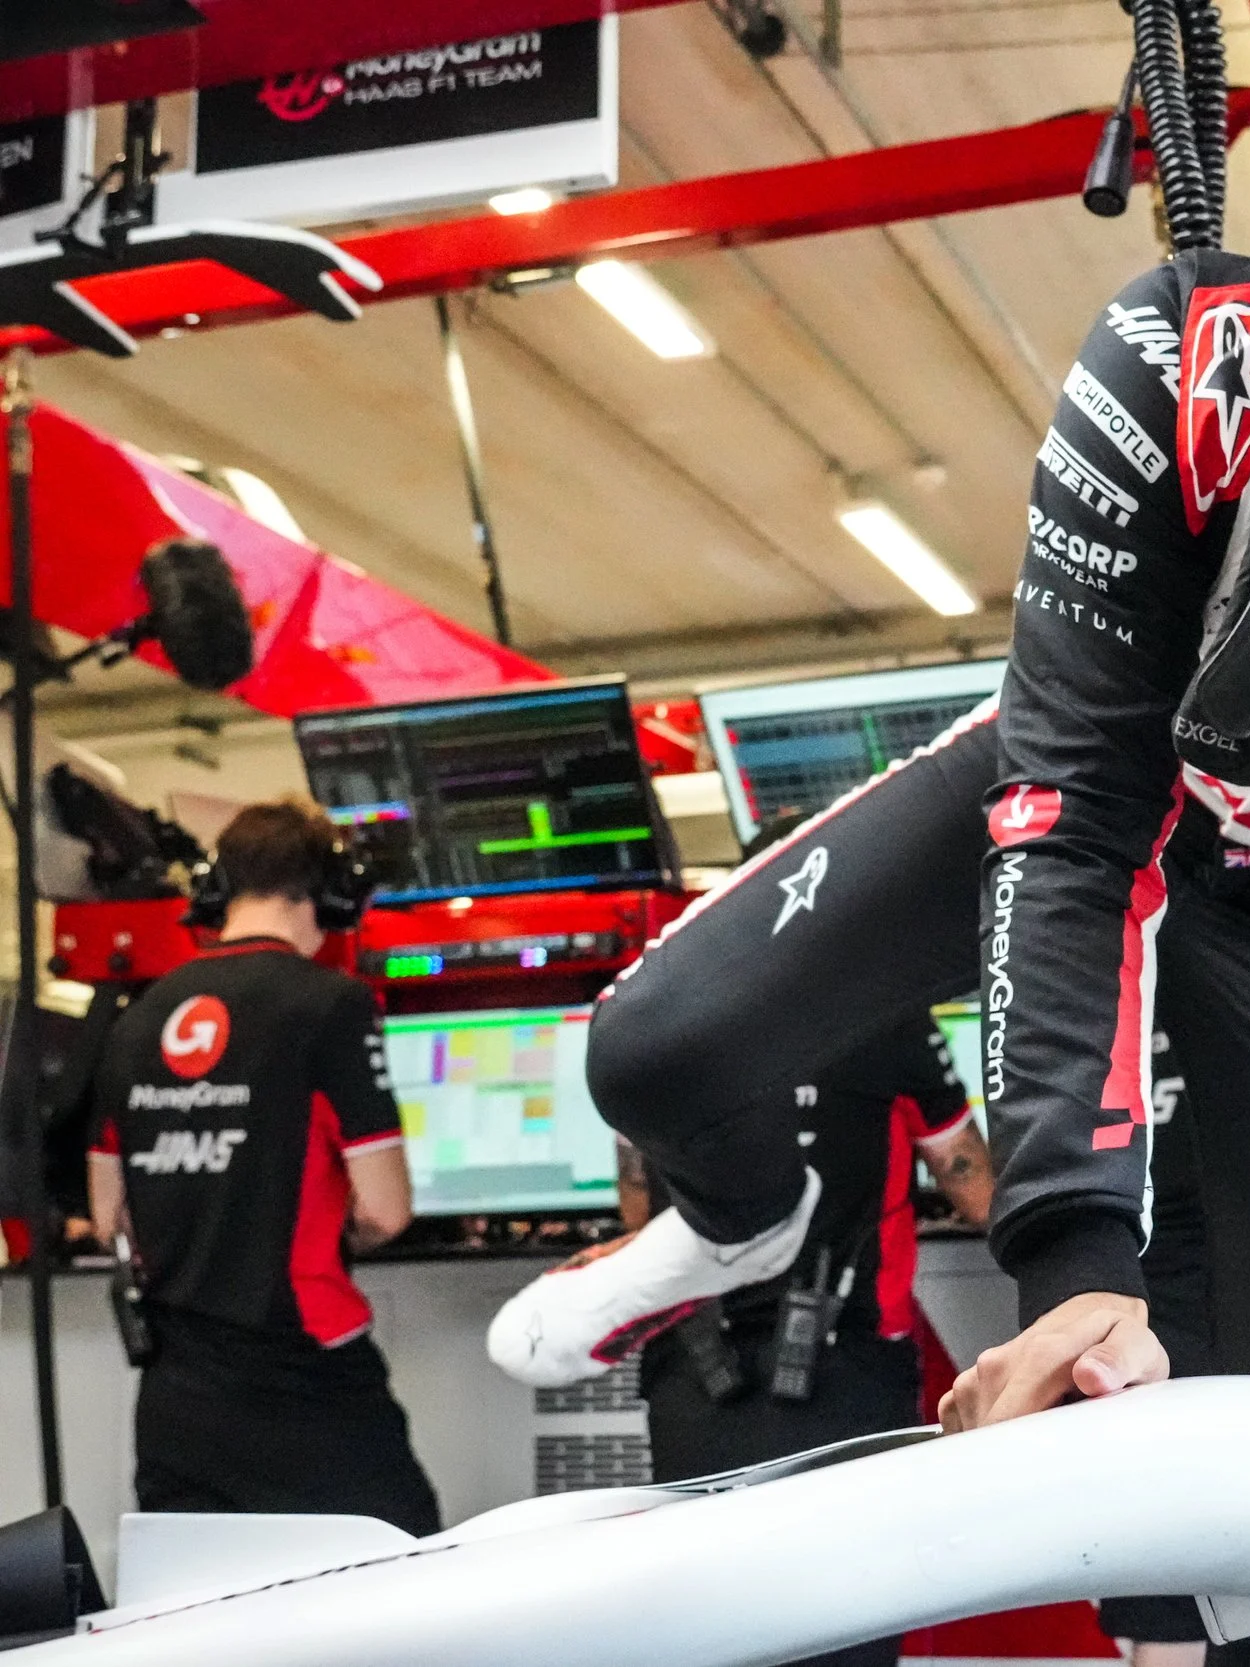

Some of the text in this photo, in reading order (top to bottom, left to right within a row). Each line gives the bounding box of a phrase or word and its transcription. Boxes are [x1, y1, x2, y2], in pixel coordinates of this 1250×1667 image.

[463, 59, 542, 88] TEAM
[1076, 379, 1160, 474] CHIPOTLE
[1028, 504, 1138, 578] RICORP
[1032, 541, 1108, 592] RKWEAR
[1174, 715, 1240, 752] EXGEL
[987, 851, 1027, 1101] MoneyGram
